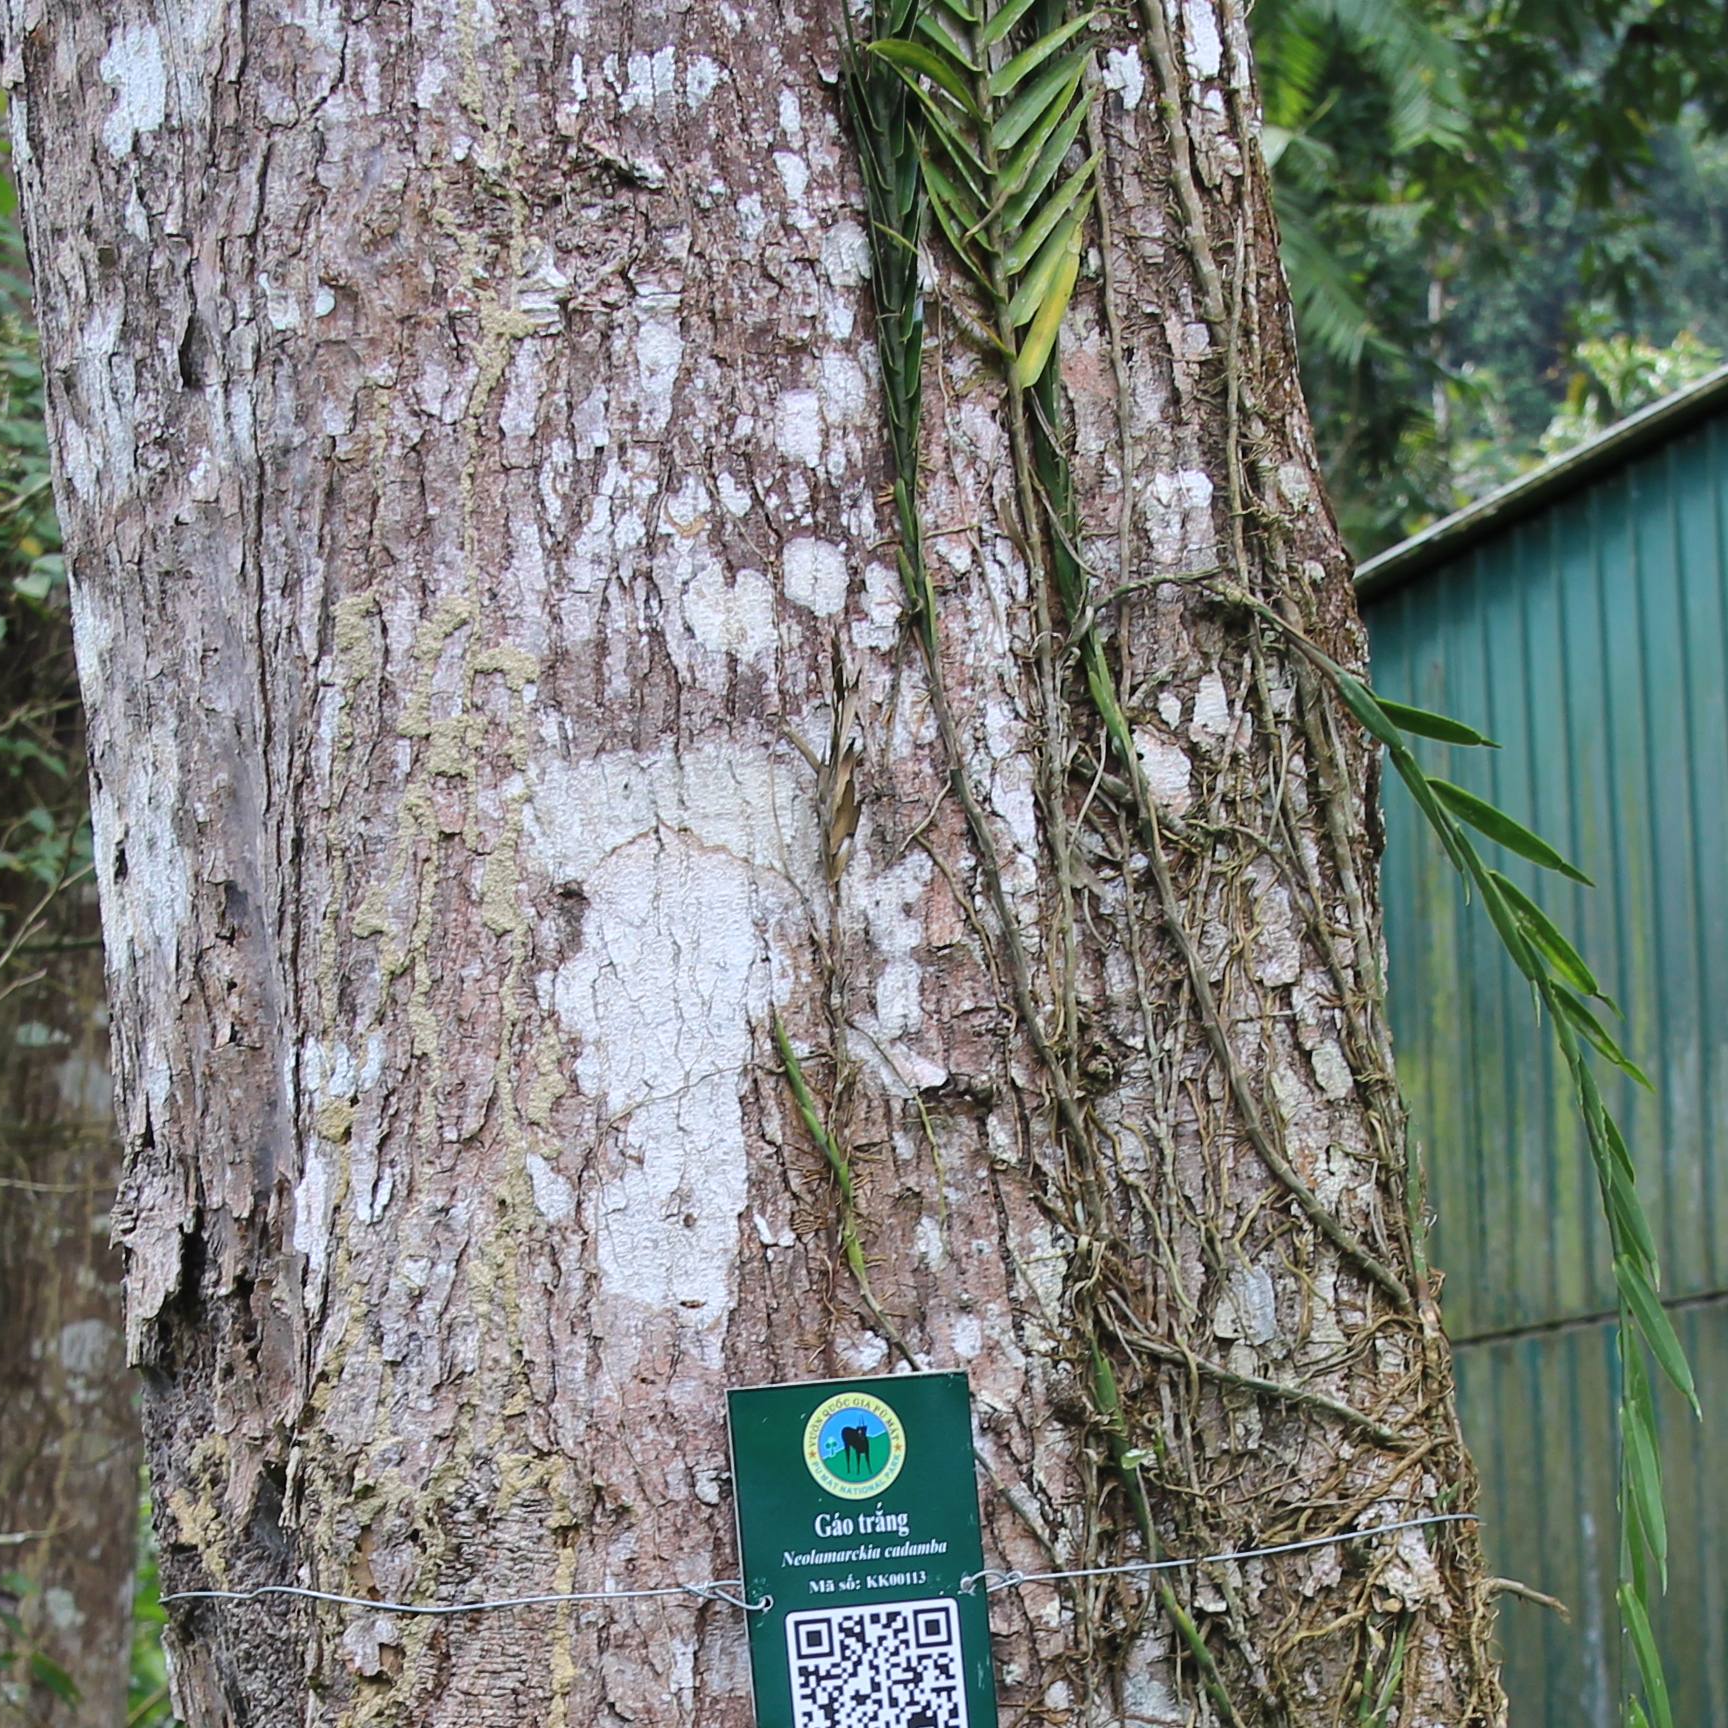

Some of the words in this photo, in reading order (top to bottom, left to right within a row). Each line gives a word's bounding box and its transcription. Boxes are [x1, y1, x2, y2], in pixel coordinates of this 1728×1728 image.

[853, 1398, 871, 1409] GIA
[839, 1479, 886, 1495] NATIONAL
[814, 1512, 854, 1538] Gáo
[858, 1502, 909, 1537] trắng
[781, 1544, 880, 1568] Neolamarckia
[884, 1538, 947, 1558] cadamba
[809, 1580, 835, 1594] Mã
[839, 1574, 861, 1591] số:
[867, 1571, 926, 1589] KK00113
